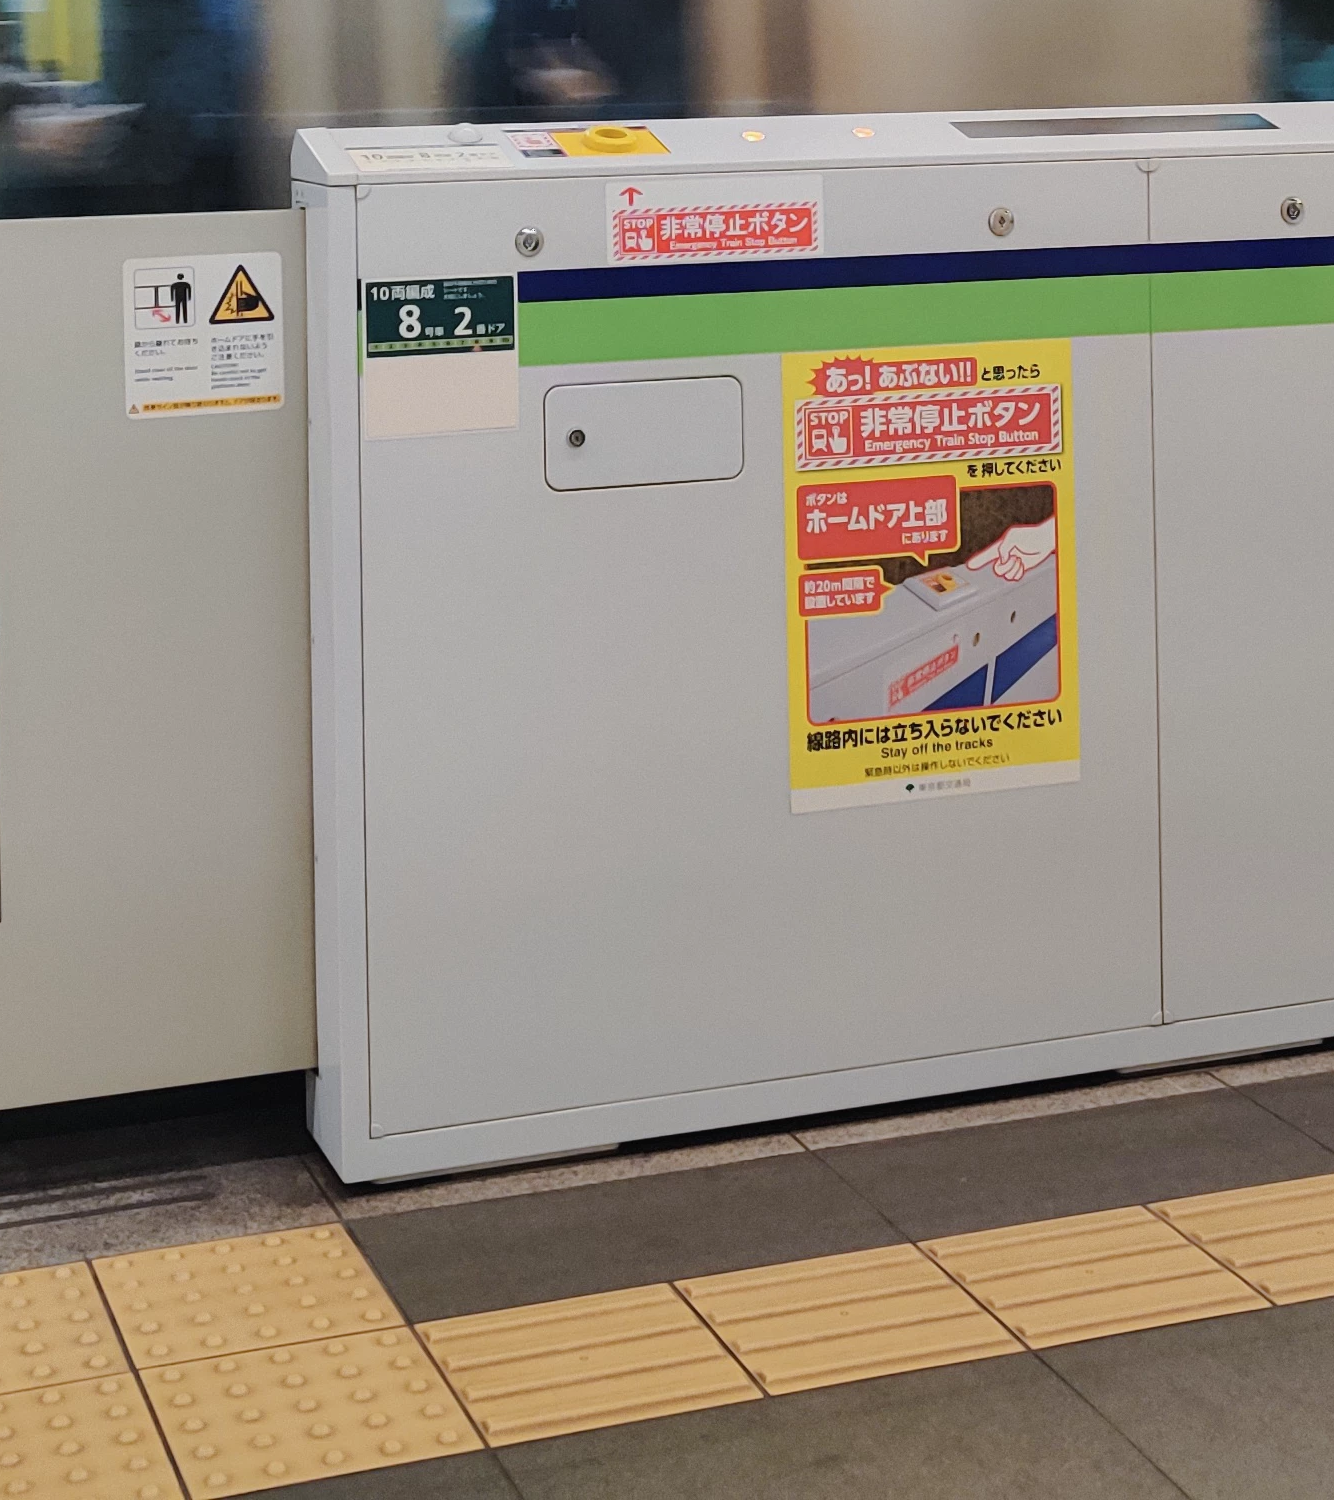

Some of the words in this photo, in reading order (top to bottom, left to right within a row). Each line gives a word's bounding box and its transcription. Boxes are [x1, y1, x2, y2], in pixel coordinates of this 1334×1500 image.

[623, 218, 653, 229] STOP
[660, 211, 808, 240] 非常停止ボタン
[720, 238, 742, 247] Train
[745, 237, 765, 247] Stop
[981, 364, 1040, 382] と思ったら
[810, 411, 848, 426] STOP
[860, 400, 1040, 438] 非常停止ボタン
[864, 438, 931, 453] Emergency
[934, 435, 965, 447] Train
[968, 432, 995, 447] Stop
[999, 430, 1038, 442] Button
[805, 492, 848, 507] ボタンは
[806, 499, 948, 534] ホームドア上部
[901, 529, 948, 544] にあります
[806, 709, 1062, 752] 線路内には立ち入らないでください
[881, 747, 907, 759] Stay
[912, 743, 929, 755] off
[933, 740, 951, 753] the
[954, 737, 993, 750] tracks
